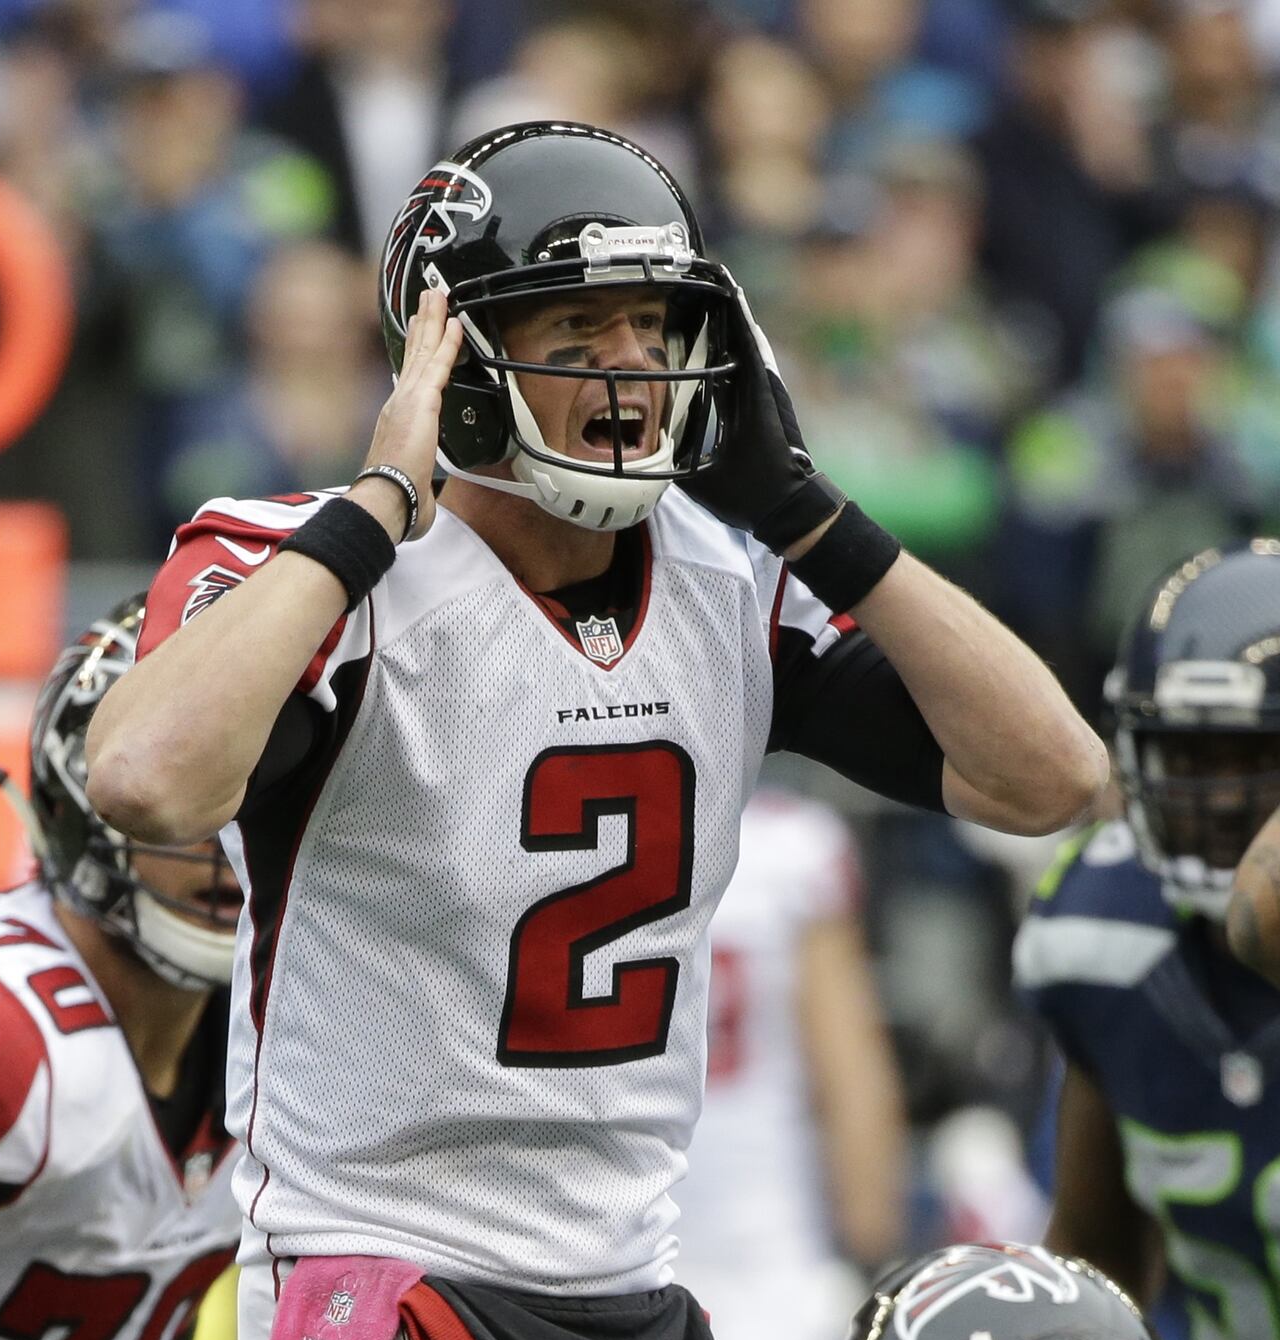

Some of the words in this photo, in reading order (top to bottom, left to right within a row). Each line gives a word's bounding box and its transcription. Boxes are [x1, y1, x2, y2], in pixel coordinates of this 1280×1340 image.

[586, 635, 619, 657] NFL
[556, 701, 671, 724] FALCONS
[496, 739, 697, 1069] 2
[328, 1304, 348, 1321] NFL
